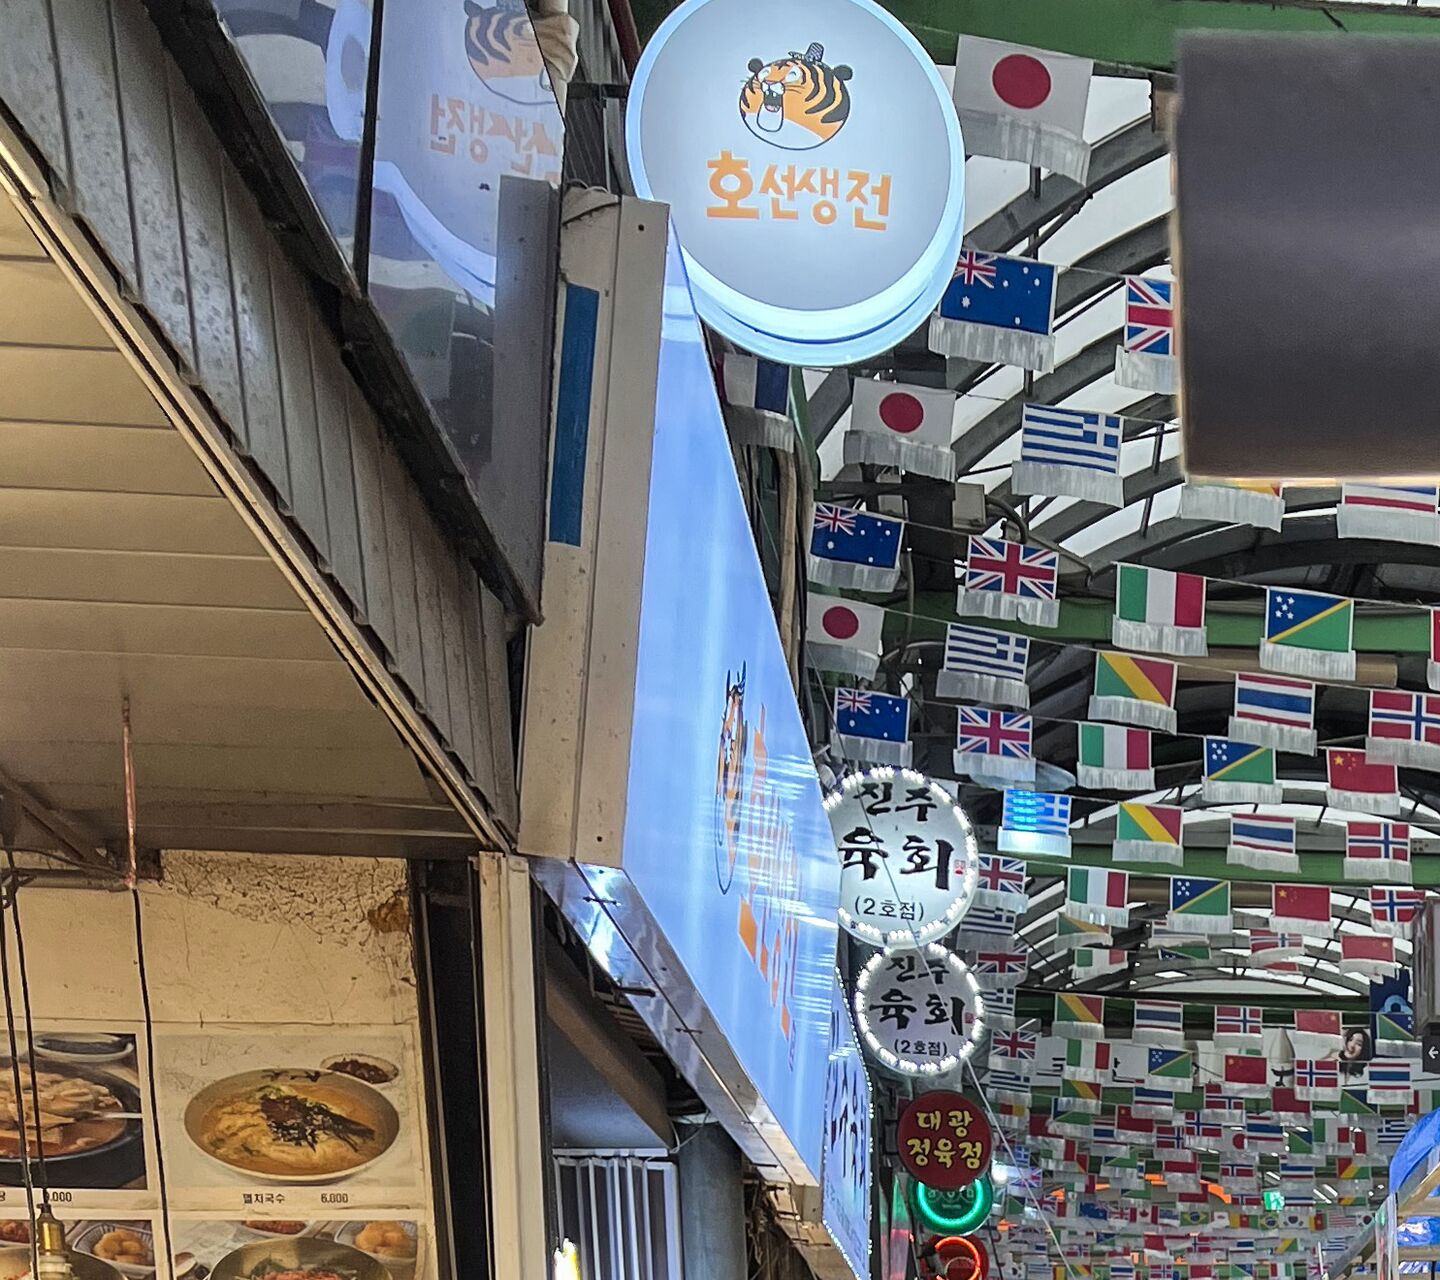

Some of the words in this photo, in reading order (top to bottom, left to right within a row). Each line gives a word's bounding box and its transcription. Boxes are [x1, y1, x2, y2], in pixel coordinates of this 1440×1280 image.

[706, 150, 892, 232] 호선생전
[853, 782, 938, 822] 진주
[838, 827, 955, 891] 육회
[854, 897, 924, 922] (2호점)
[884, 956, 950, 985] 진주
[869, 988, 966, 1036] 육회
[894, 1038, 948, 1056] (2호점)
[916, 1110, 974, 1138] 대광
[907, 1138, 984, 1169] 정육점
